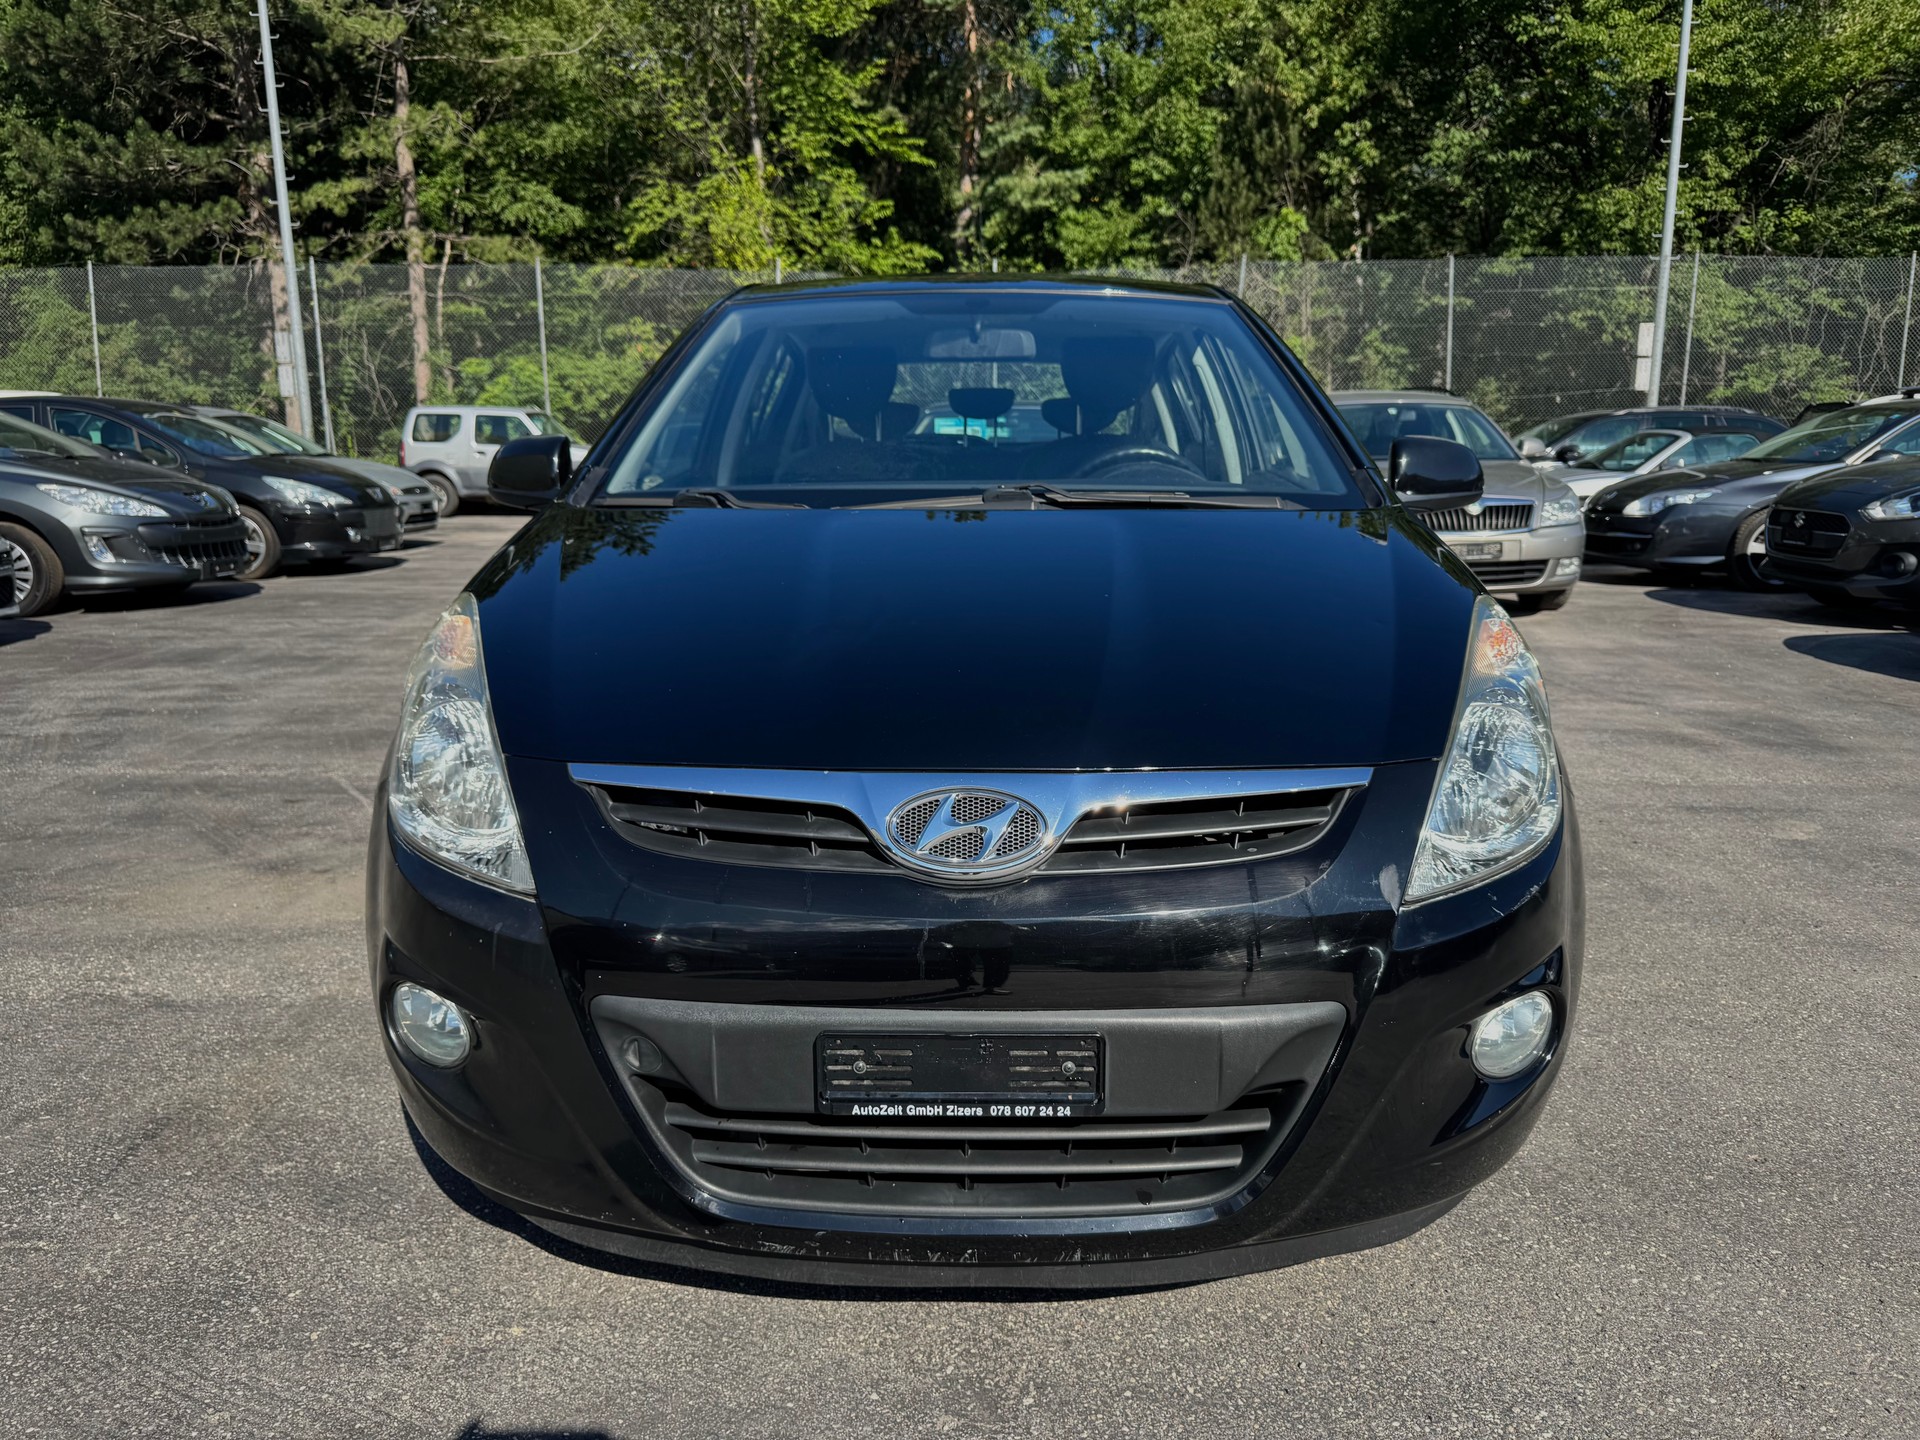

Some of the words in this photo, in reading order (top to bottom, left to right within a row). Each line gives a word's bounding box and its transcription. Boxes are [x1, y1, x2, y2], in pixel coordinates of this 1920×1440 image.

[906, 1104, 943, 1116] GmbH
[989, 1105, 1012, 1117] 078
[1014, 1105, 1036, 1117] 607
[1039, 1105, 1054, 1117] 24
[1056, 1105, 1072, 1117] 24
